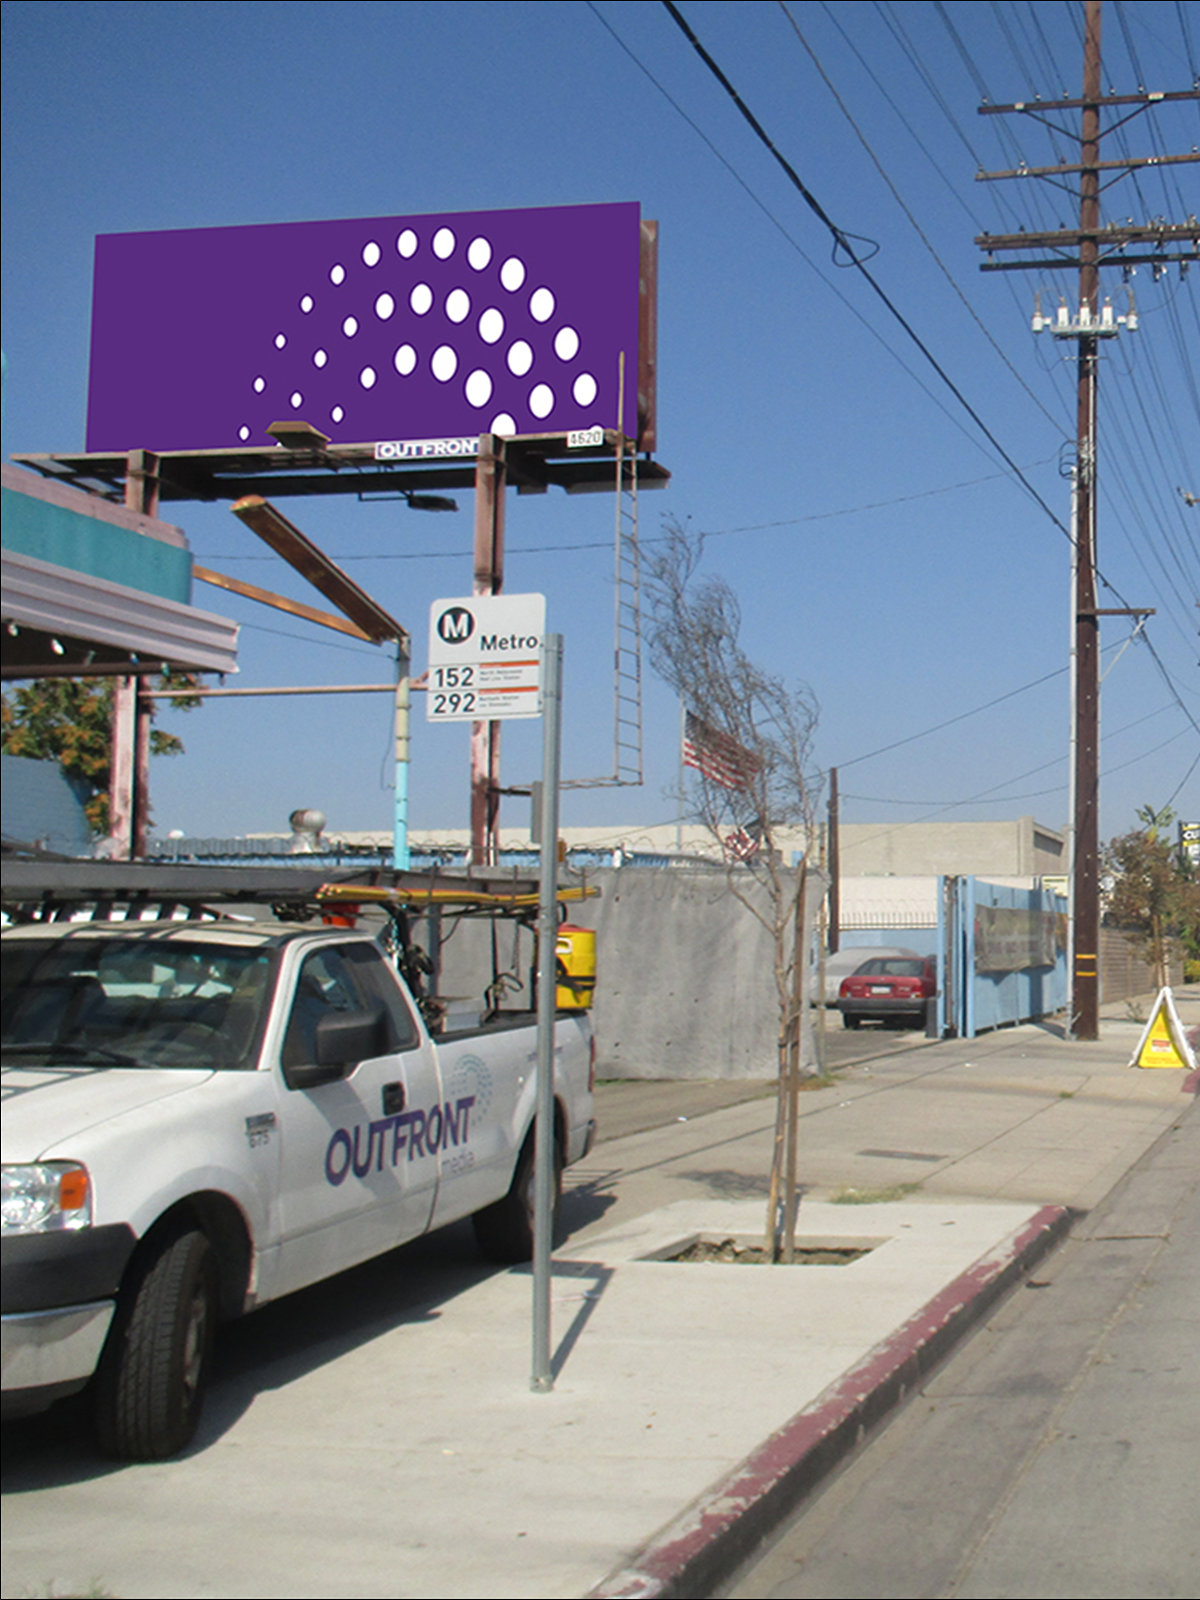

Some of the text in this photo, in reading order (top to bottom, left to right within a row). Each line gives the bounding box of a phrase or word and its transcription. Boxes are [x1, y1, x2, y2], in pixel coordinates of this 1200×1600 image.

[380, 439, 480, 457] OUTFRON
[480, 634, 539, 651] Metro
[434, 667, 475, 688] 152
[433, 692, 476, 714] 292
[325, 1095, 477, 1187] OUTFRONT
